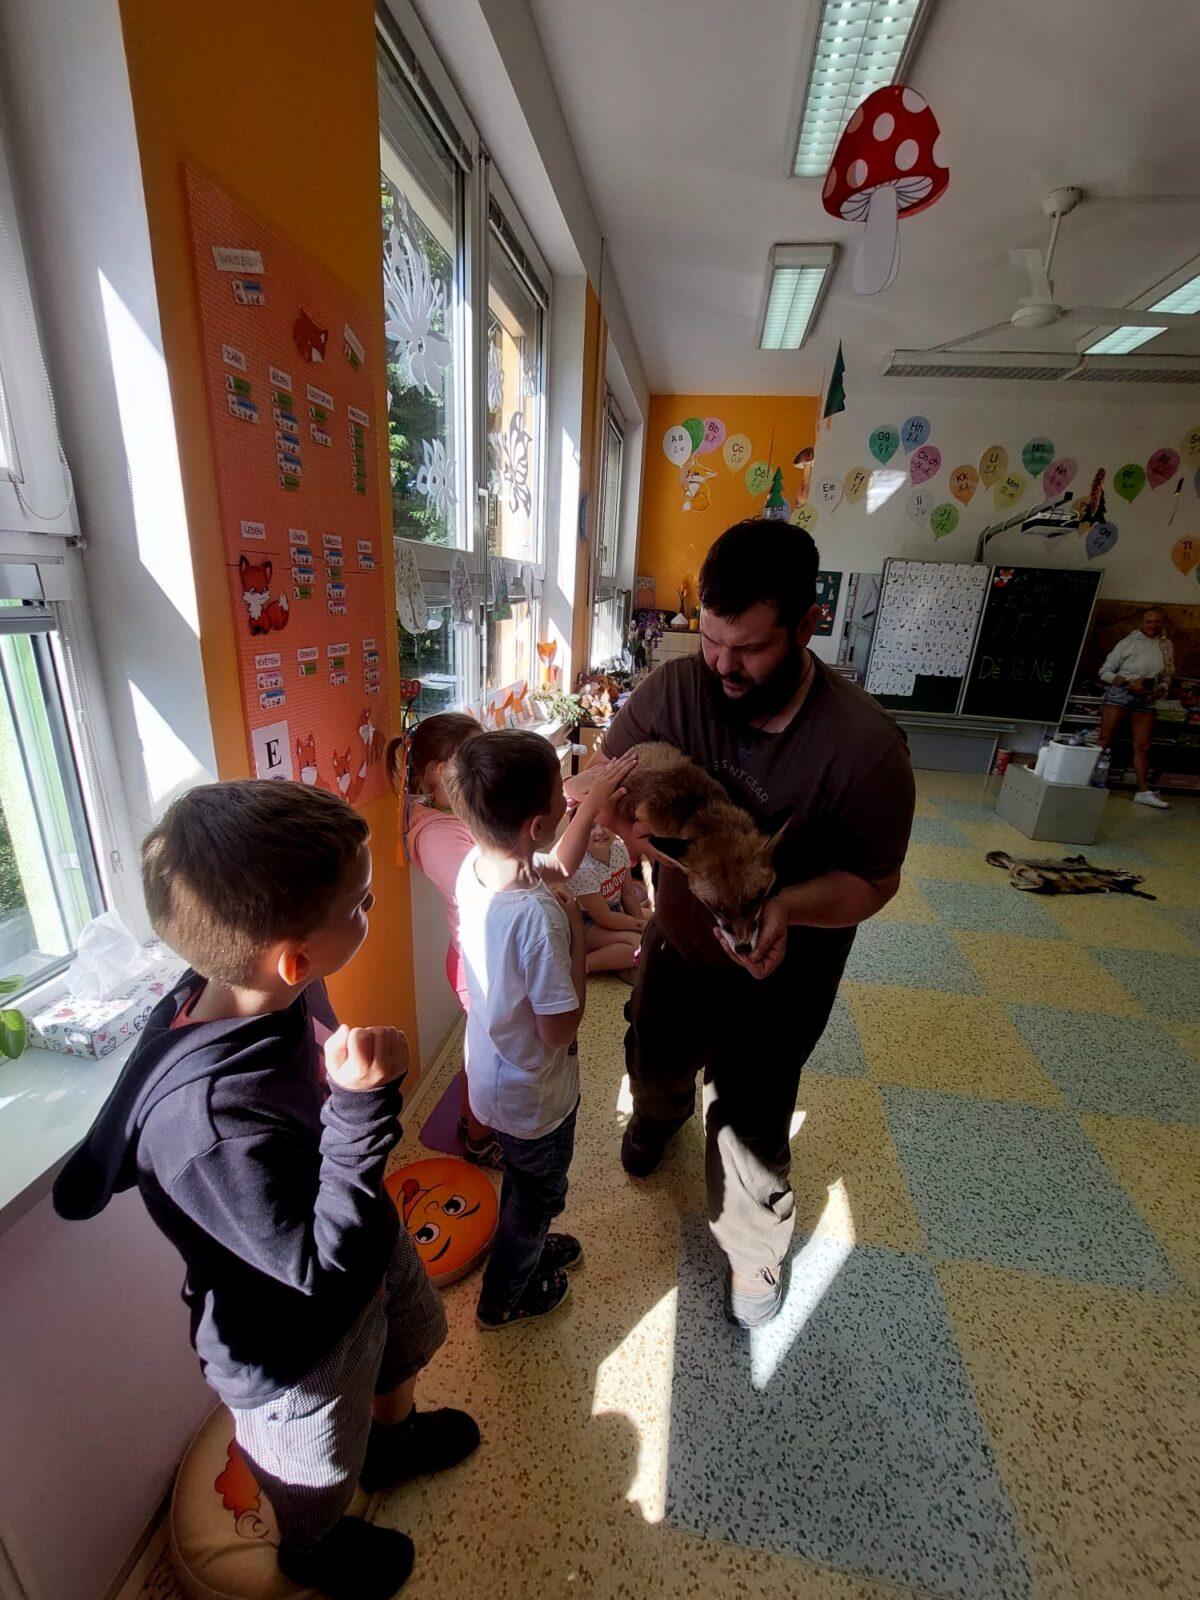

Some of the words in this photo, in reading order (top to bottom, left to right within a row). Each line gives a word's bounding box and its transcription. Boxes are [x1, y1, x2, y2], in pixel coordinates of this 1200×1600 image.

[708, 422, 720, 434] Bb
[910, 420, 924, 433] Hh
[877, 431, 890, 442] Gg
[732, 443, 745, 453] Cc
[1032, 443, 1045, 454] Nn
[956, 472, 969, 483] Kk
[1005, 476, 1020, 490] Mm
[822, 483, 835, 493] Ee
[264, 739, 282, 770] E
[745, 776, 769, 803] GEAR
